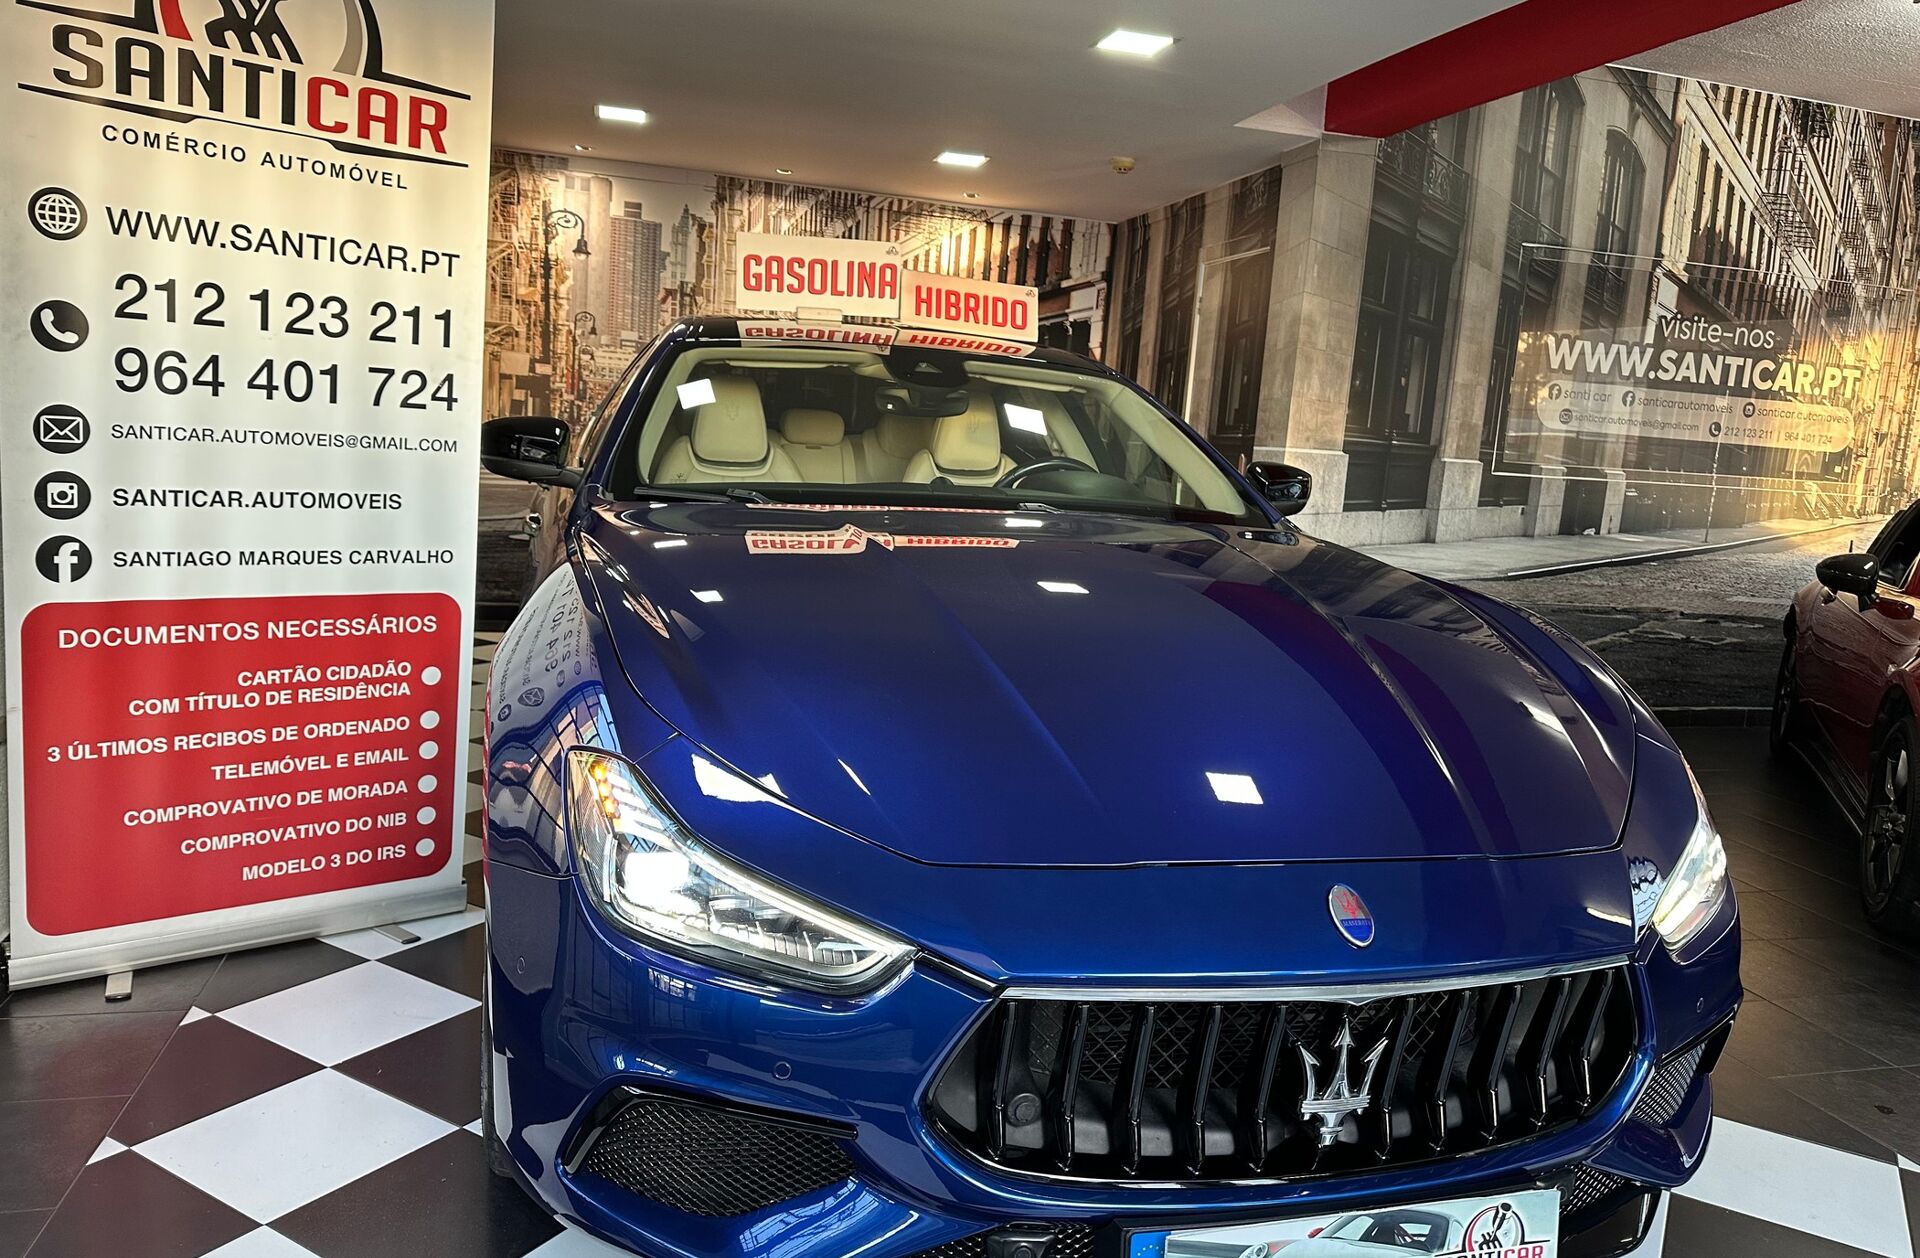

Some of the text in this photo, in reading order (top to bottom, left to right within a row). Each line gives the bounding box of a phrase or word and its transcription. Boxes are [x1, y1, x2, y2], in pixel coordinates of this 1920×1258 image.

[52, 24, 447, 154] SANTICAR
[102, 125, 408, 190] COMÉRCIO AUTOMÓVEL
[106, 207, 460, 277] WWW.SANTICAR.PT
[743, 254, 898, 299] GASOLINA
[114, 274, 452, 348] 212 123 211
[915, 285, 1028, 330] HIBRIDO
[1660, 314, 1776, 349] visite-nos
[114, 347, 458, 411] 964 401 724
[1548, 336, 1862, 398] WWW.SANTICAR.PT
[111, 424, 457, 453] SANTICAR.AUTOMOVEIS@GMAIL.COM
[1724, 426, 1739, 437] 212
[1743, 428, 1757, 438] 123
[1759, 429, 1773, 440] 211
[1784, 431, 1799, 442] 964
[112, 489, 402, 510] SANTICAR.AUTOMOVEIS
[113, 549, 454, 567] SANTIAGO MARQUES CARVALHO
[58, 614, 437, 649] DOCUMENTOS NECESSÁRIOS
[237, 660, 412, 687] CARTÃO CIDADÃO
[128, 682, 411, 716] COM TÍTULO DE RESIDÊNCIA
[47, 716, 410, 763] 3 ÚLTIMOS RECIBOS DE ORDENADO
[211, 748, 409, 781] TELEMÓVEL E EMAIL
[123, 780, 408, 827] COMPROVATIVO DE MORADA
[181, 812, 407, 855] COMPROVATIVO DO NIB
[242, 844, 407, 881] MODELO 3 DO IRS
